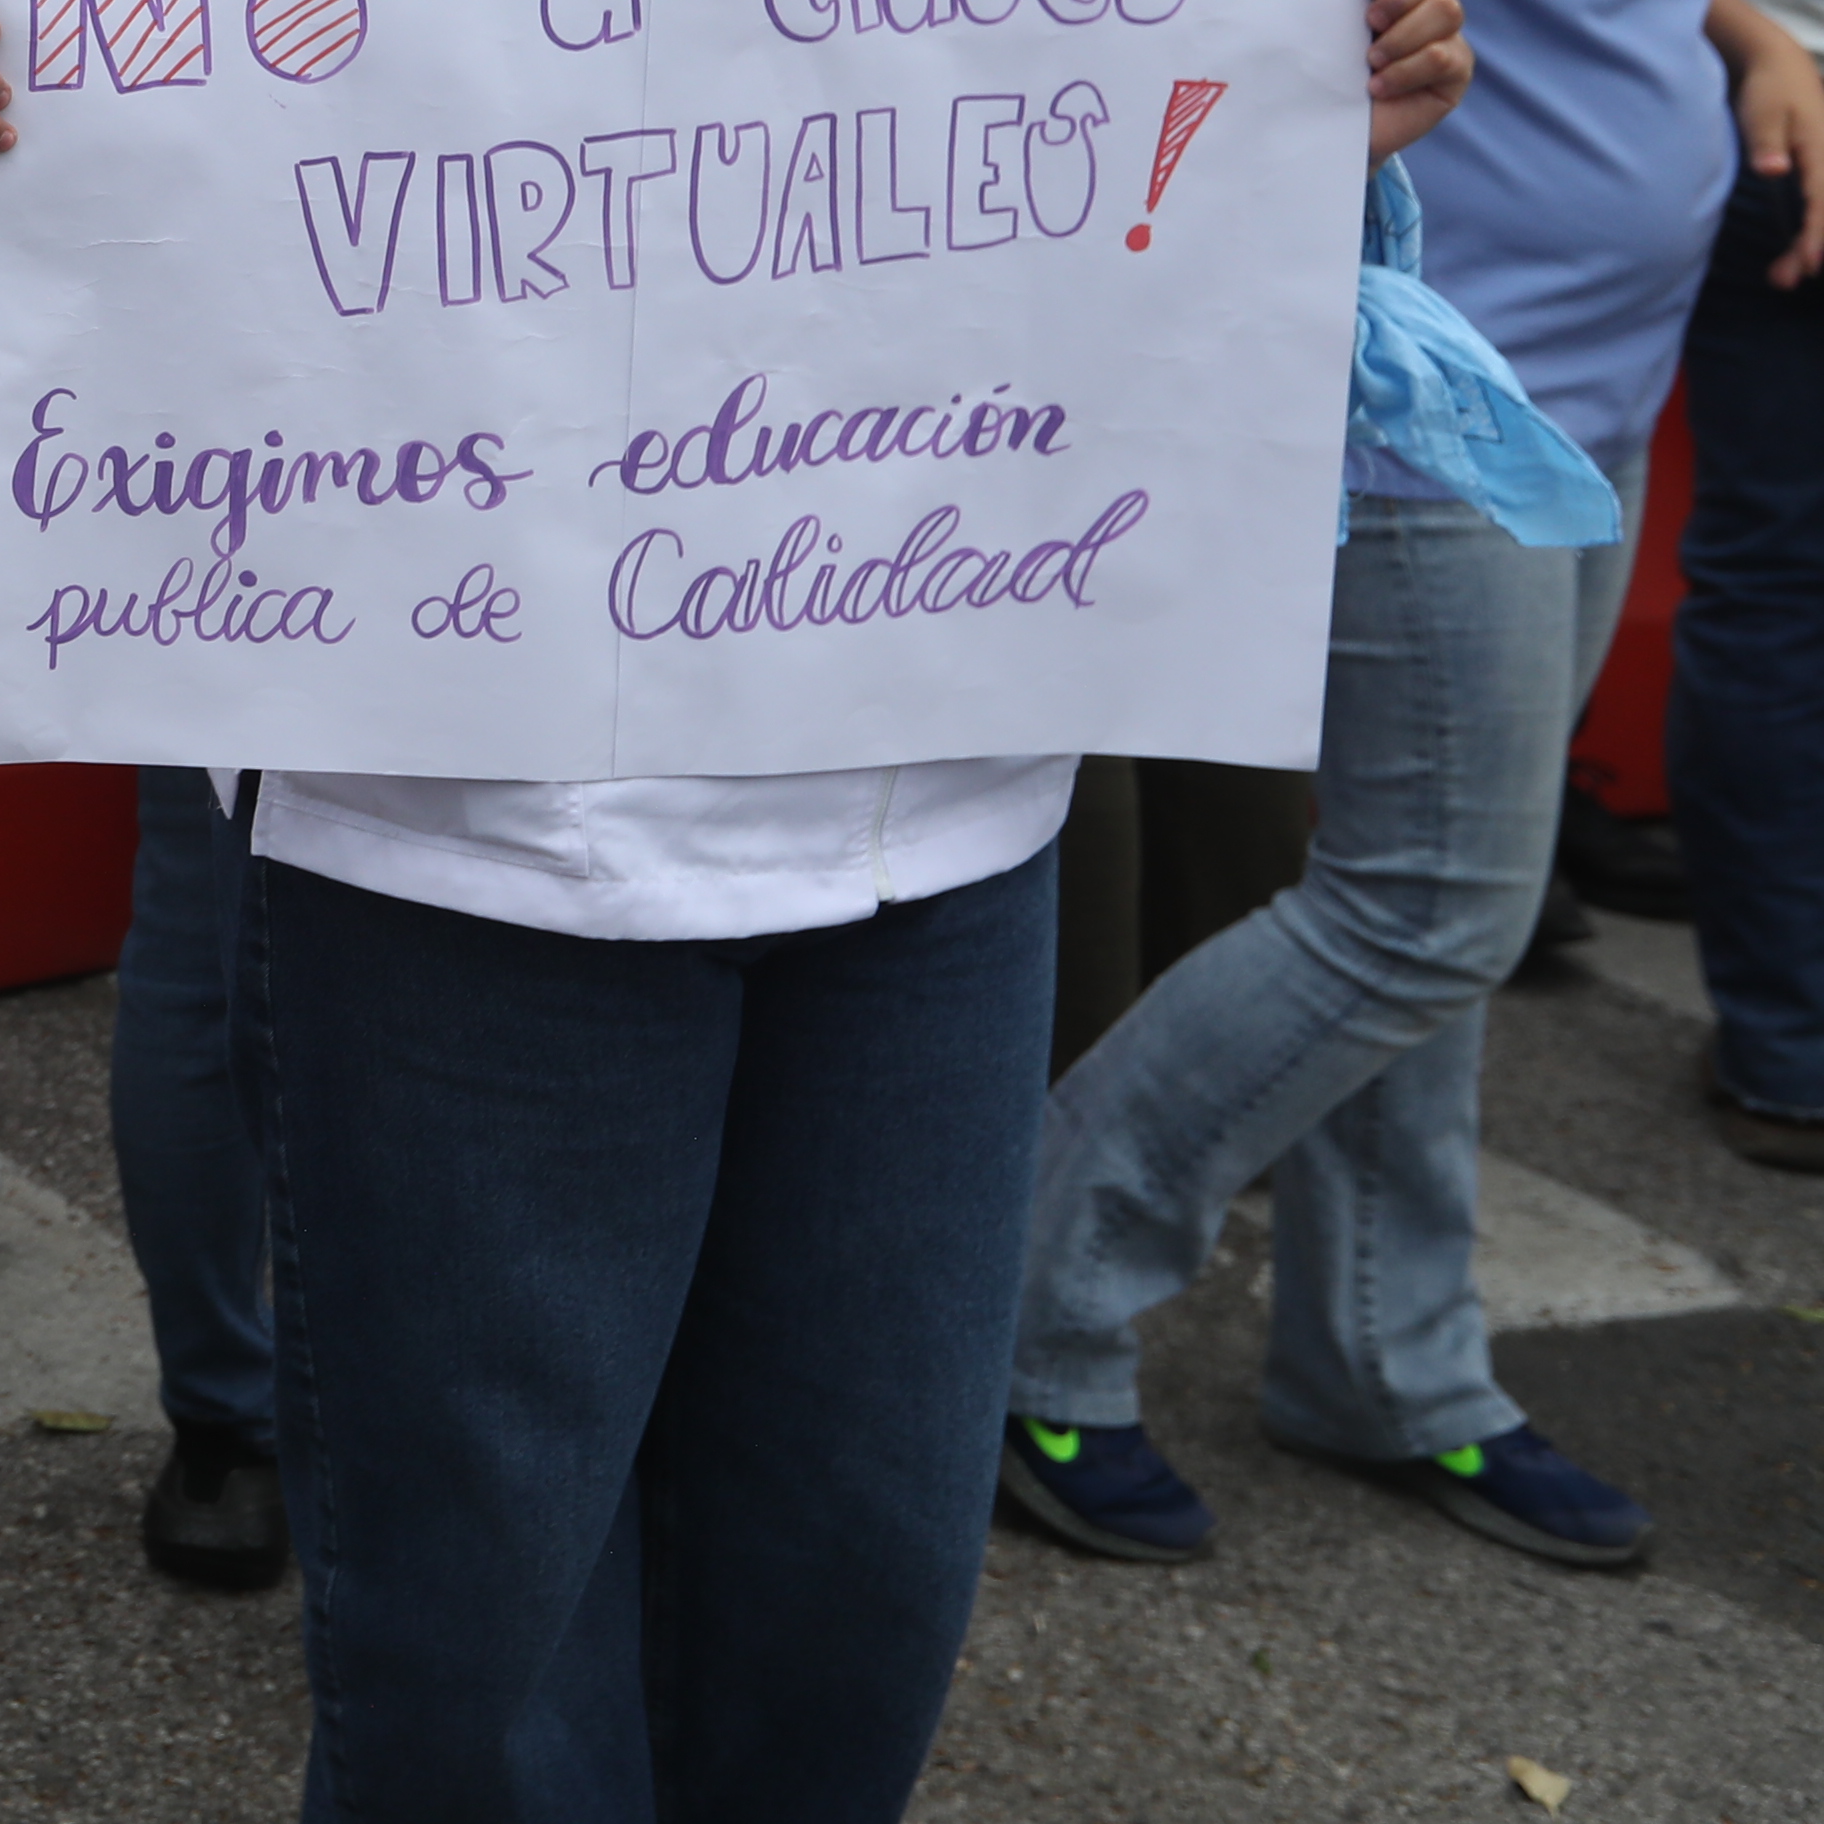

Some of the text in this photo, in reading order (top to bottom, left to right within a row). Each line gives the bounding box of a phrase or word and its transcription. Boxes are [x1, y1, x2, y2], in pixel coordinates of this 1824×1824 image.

[12, 372, 1070, 559] Exigimos educación
[27, 488, 1150, 671] publica de Calidad
